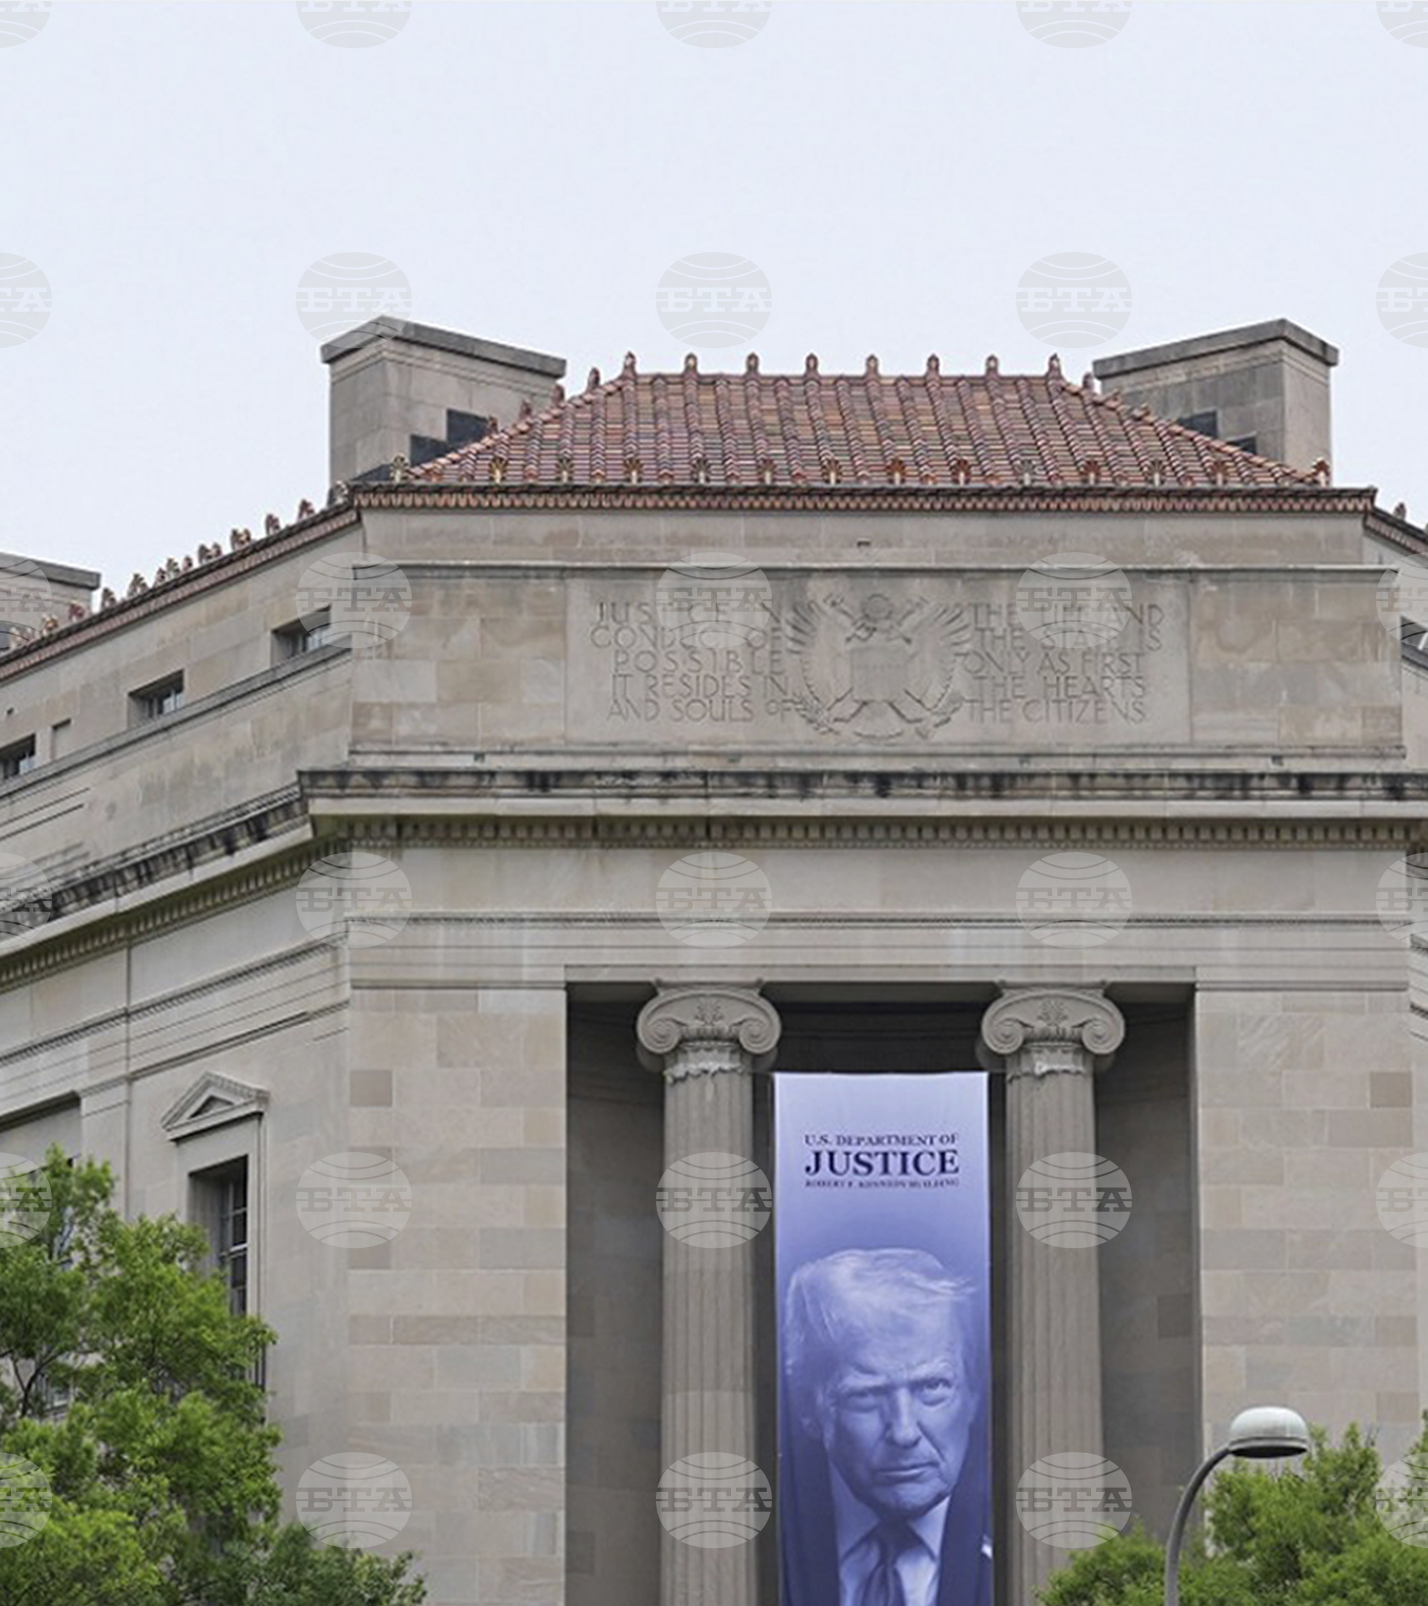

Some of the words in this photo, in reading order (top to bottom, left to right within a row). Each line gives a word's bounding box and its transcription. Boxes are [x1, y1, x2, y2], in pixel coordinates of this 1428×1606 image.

[613, 649, 786, 674] POSSIBLE
[644, 673, 752, 700] RESIDES
[670, 698, 755, 722] SOULS
[803, 1133, 833, 1147] U.S.
[835, 1134, 937, 1147] DEPARTMENT
[938, 1133, 959, 1145] OF
[804, 1149, 960, 1177] JUSTICE
